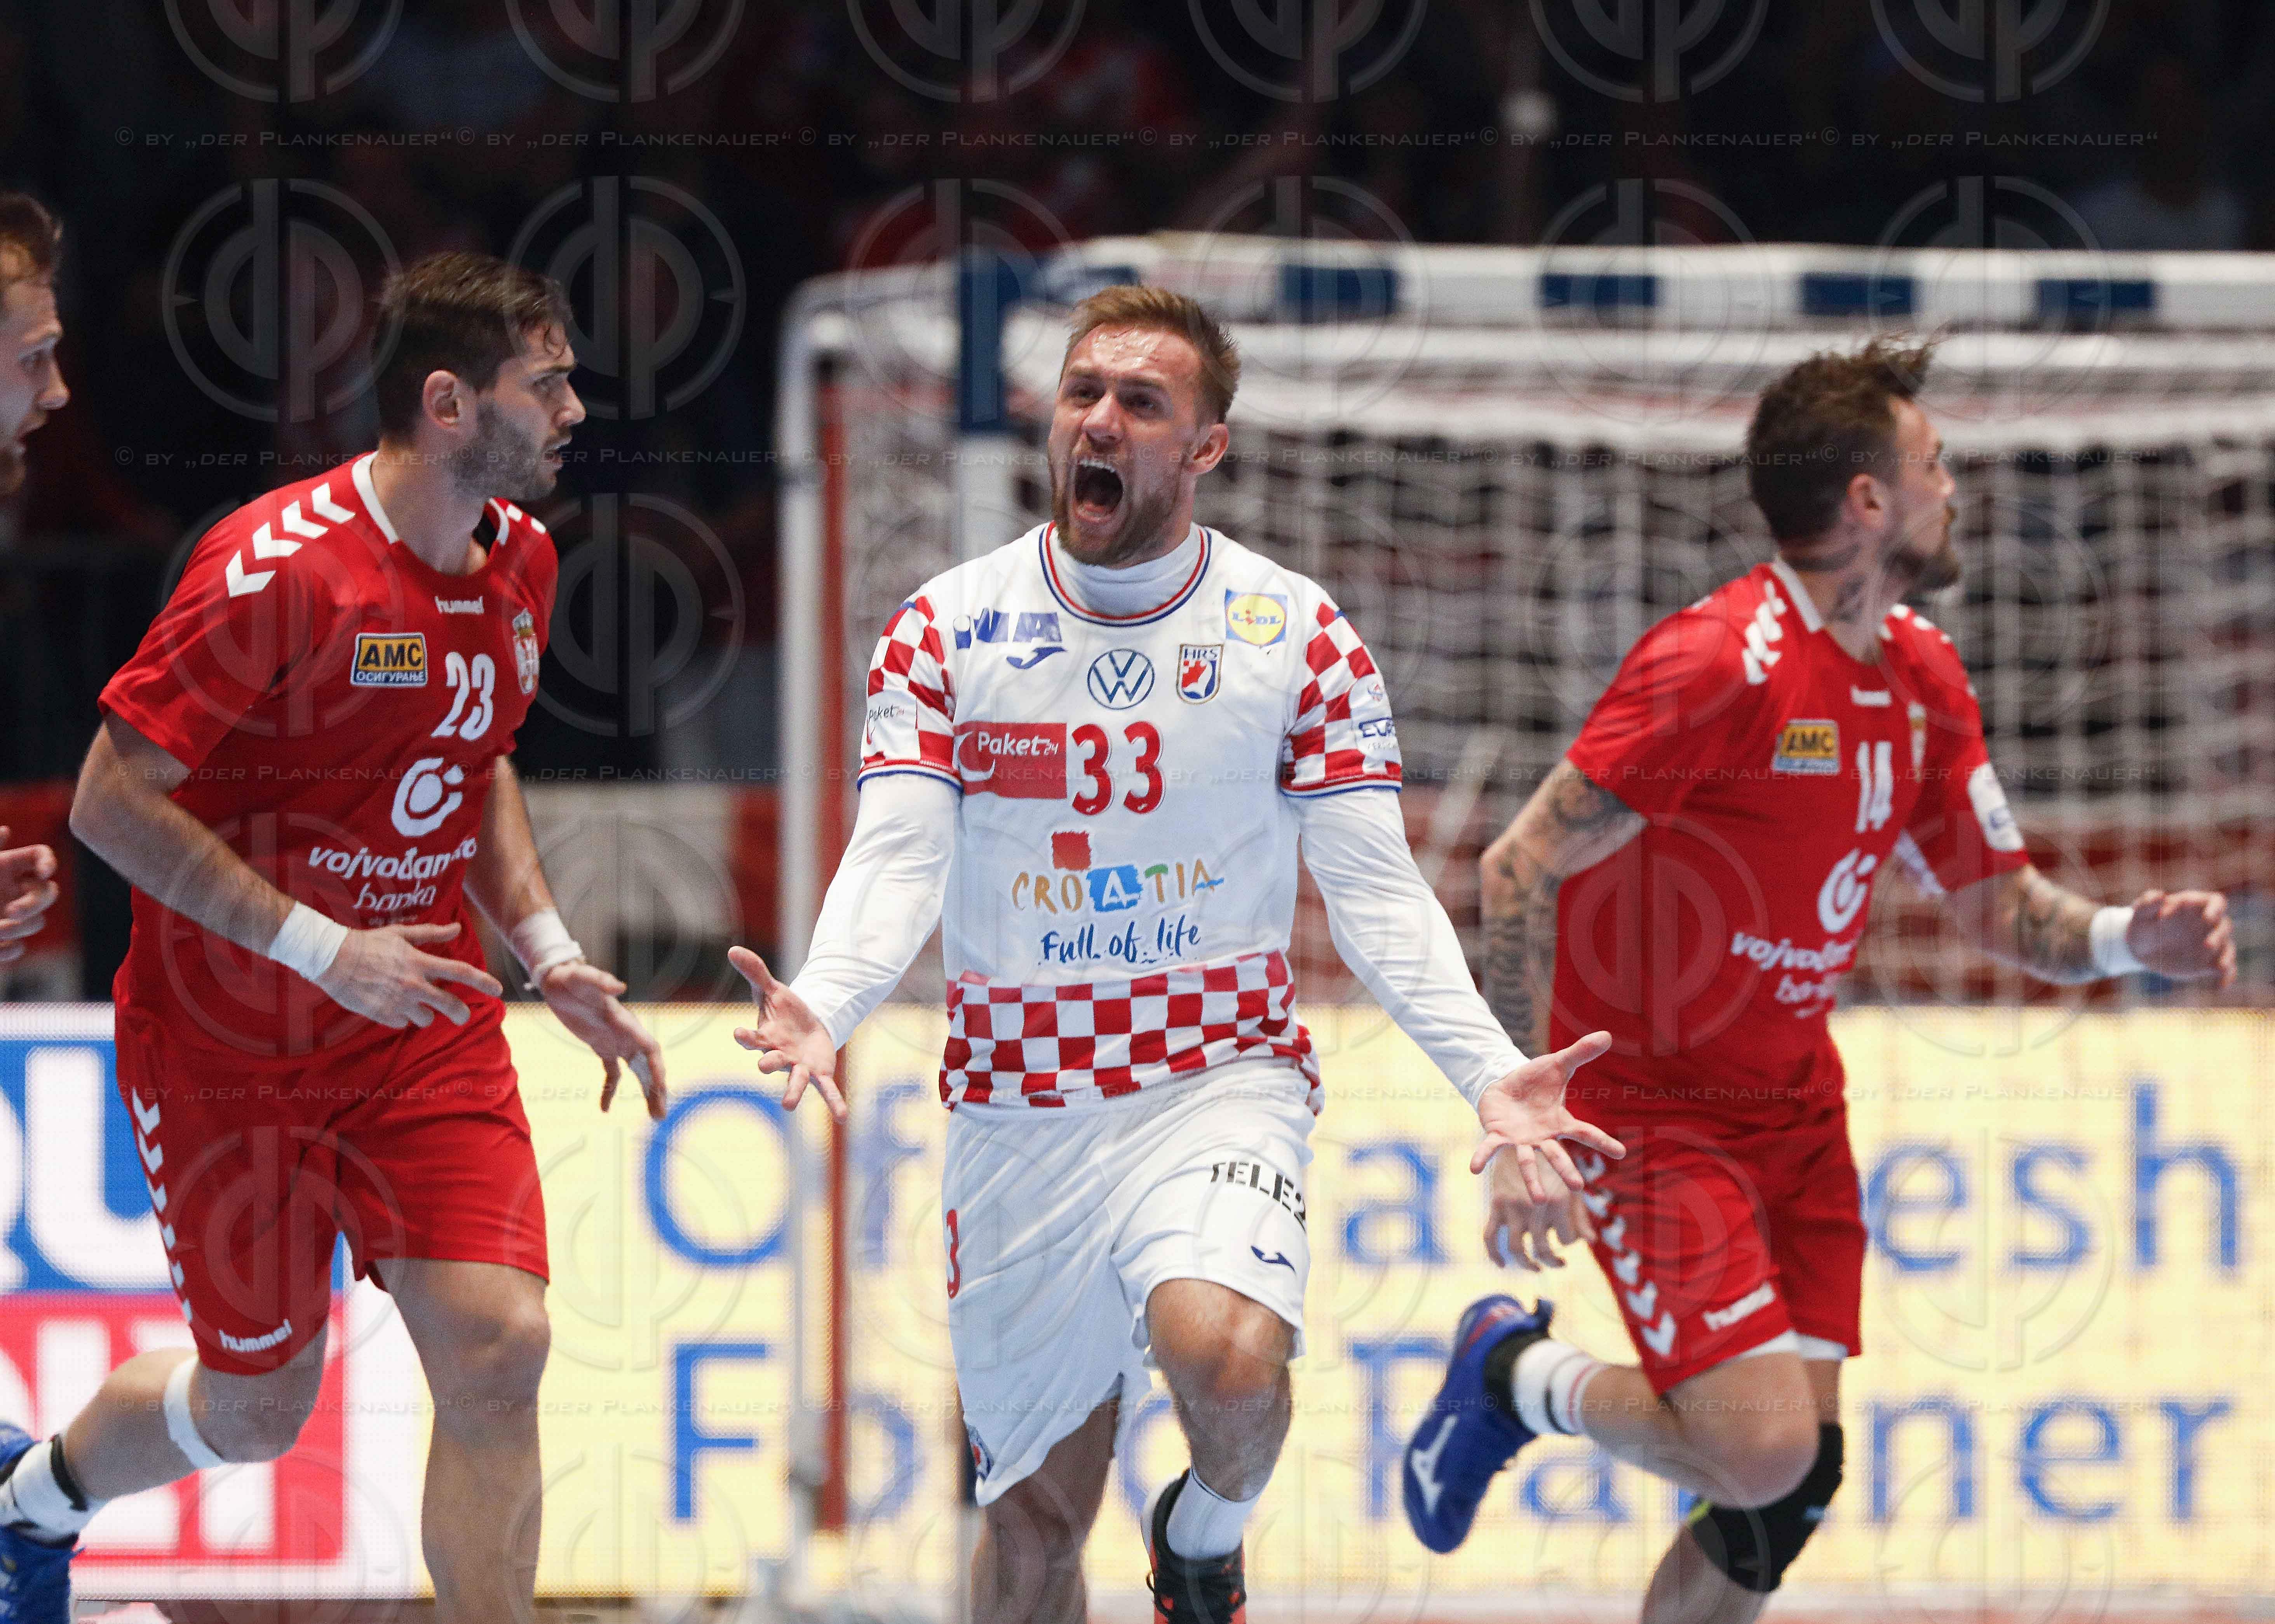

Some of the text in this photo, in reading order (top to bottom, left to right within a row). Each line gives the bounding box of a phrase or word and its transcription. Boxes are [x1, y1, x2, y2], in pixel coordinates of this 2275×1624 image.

[430, 651, 496, 741] 23
[1072, 721, 1165, 815] 33
[1012, 858, 1225, 915] CROATIA
[1040, 914, 1201, 963] Full of life
